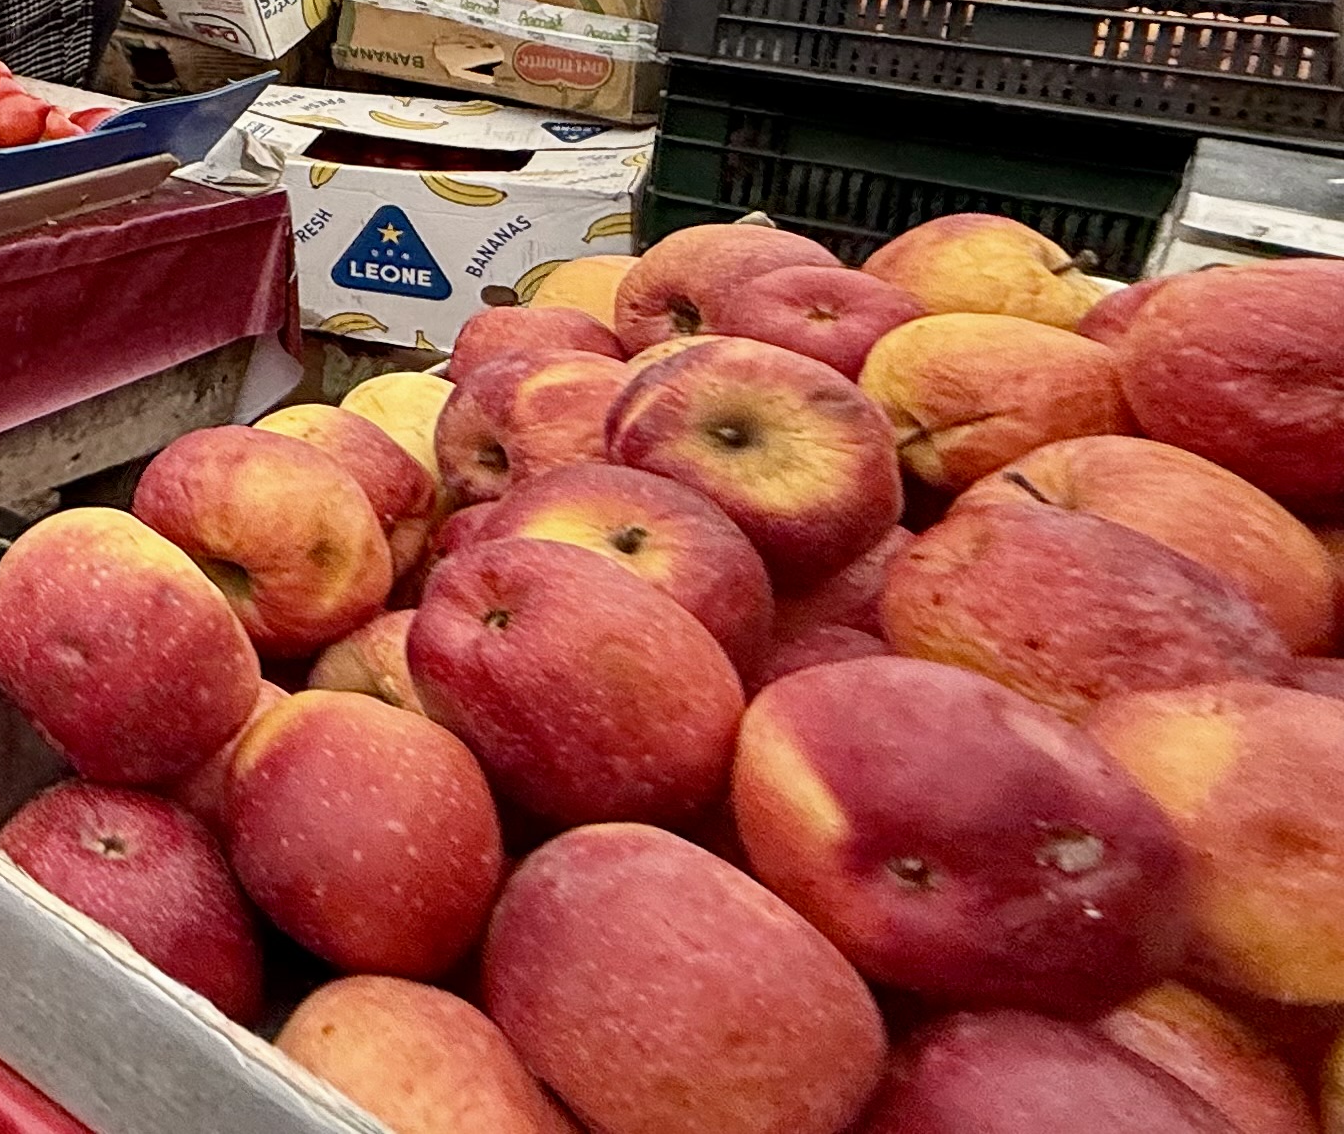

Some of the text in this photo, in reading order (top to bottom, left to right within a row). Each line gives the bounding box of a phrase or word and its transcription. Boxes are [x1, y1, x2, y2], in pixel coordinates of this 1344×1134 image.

[519, 53, 573, 74] Monte
[465, 215, 532, 278] BANANAS
[350, 260, 432, 287] LEONE
